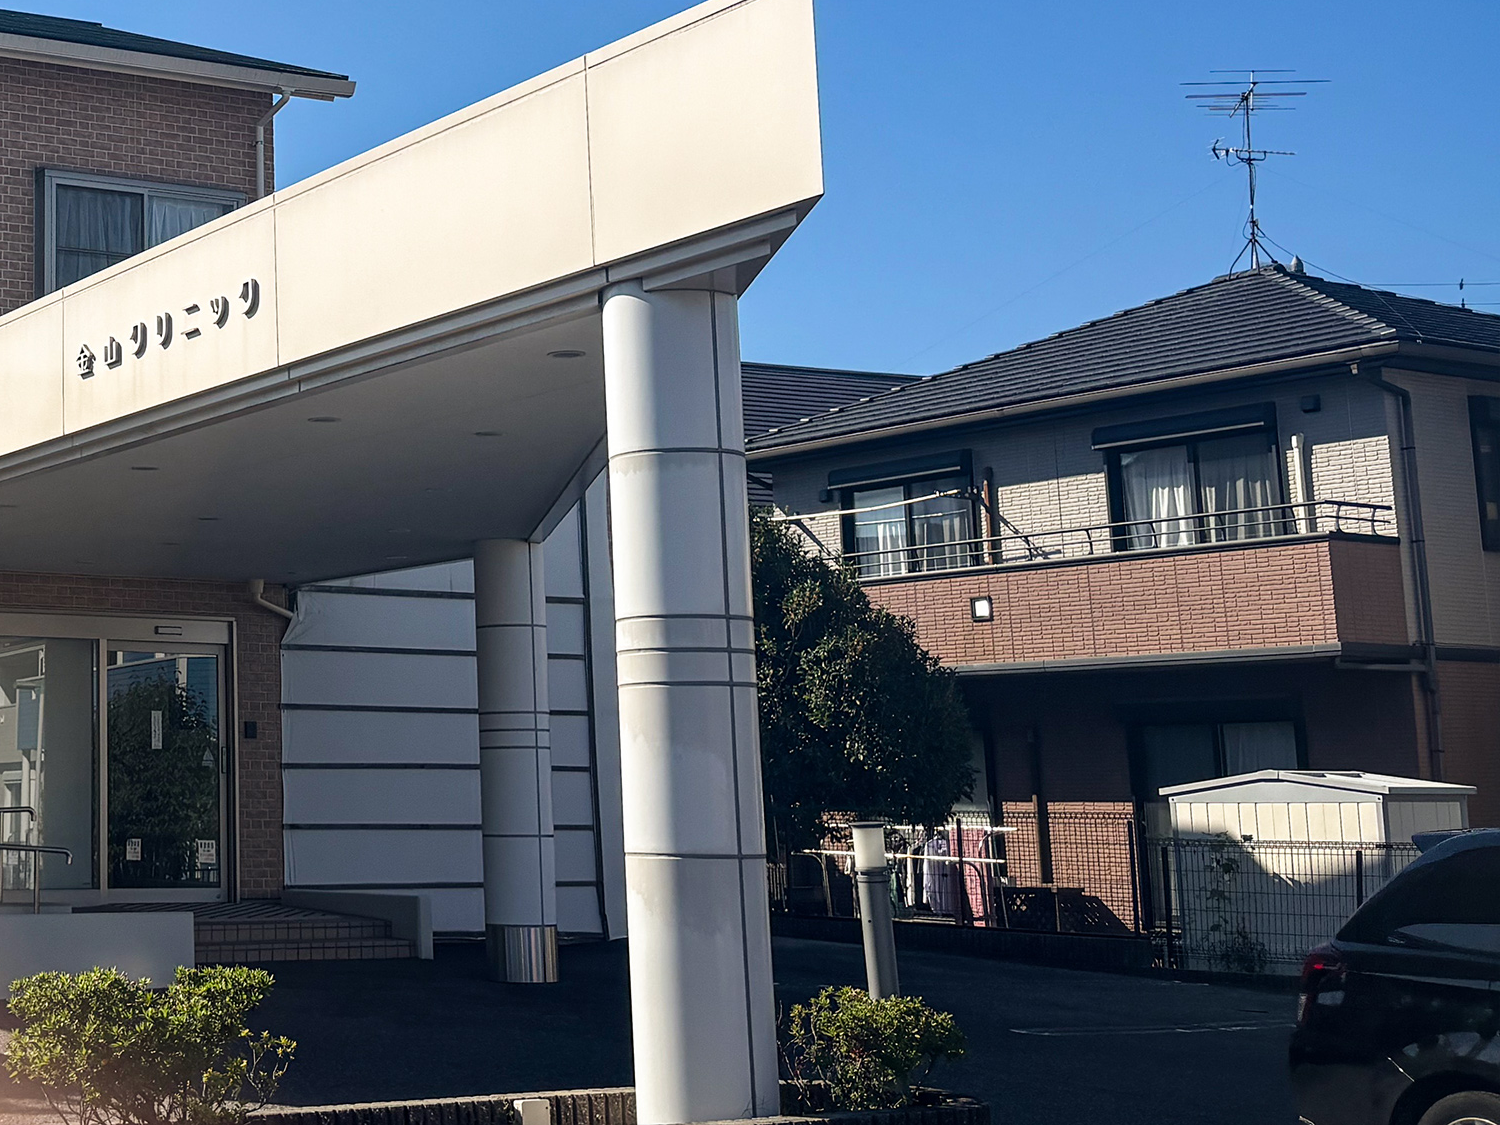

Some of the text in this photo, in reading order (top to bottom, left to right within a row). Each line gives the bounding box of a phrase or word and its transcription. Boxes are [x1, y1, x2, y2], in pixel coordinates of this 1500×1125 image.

[76, 278, 260, 380] 金山クリニック
